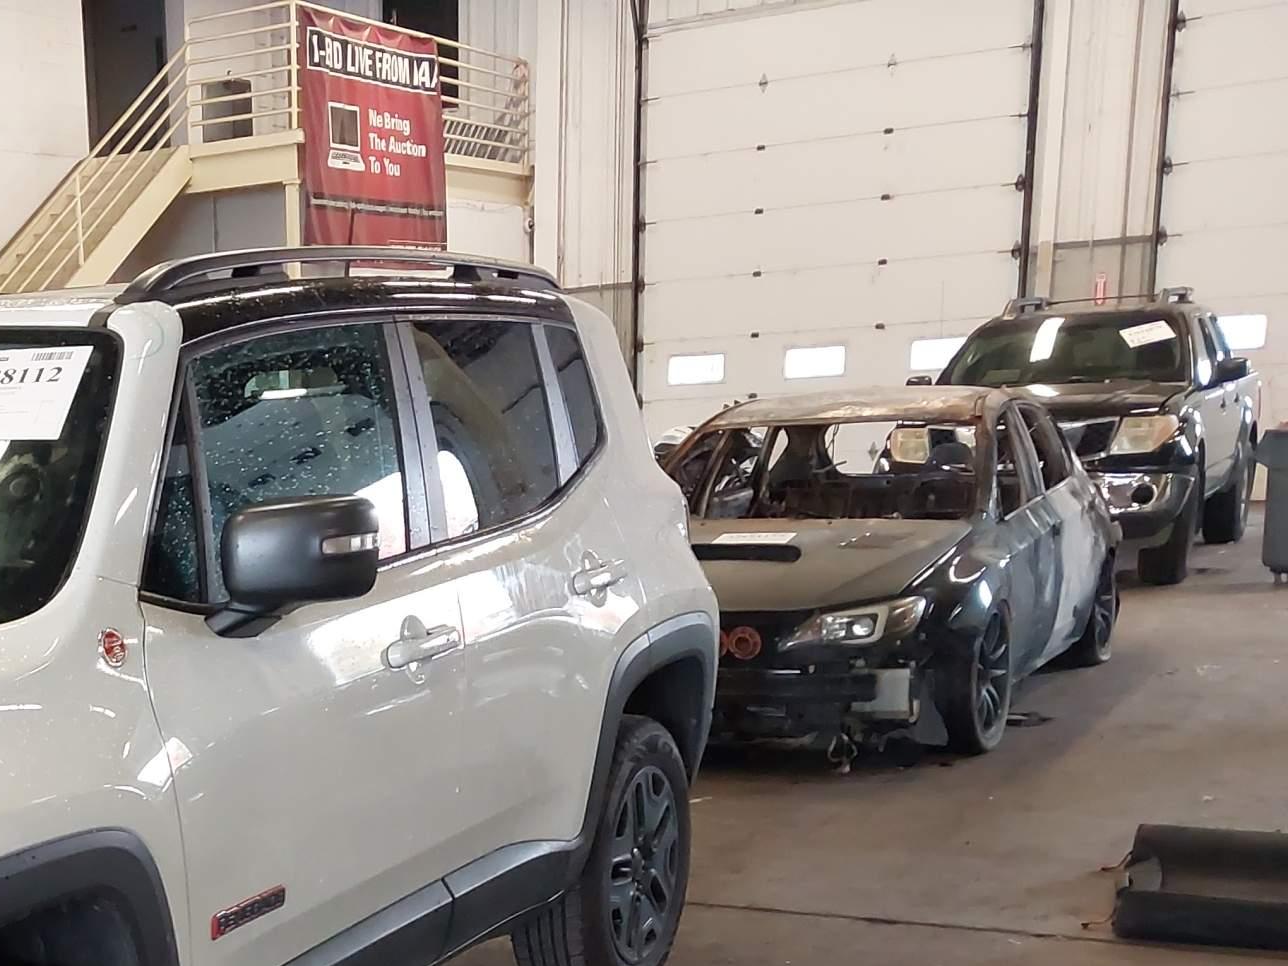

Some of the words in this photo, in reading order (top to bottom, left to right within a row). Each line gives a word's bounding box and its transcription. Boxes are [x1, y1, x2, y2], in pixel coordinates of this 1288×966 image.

[346, 43, 374, 77] LIVE
[376, 51, 411, 86] FROM
[384, 111, 411, 136] Bring
[368, 132, 387, 152] The
[388, 136, 426, 158] Auction
[368, 156, 380, 175] To
[383, 157, 401, 177] You
